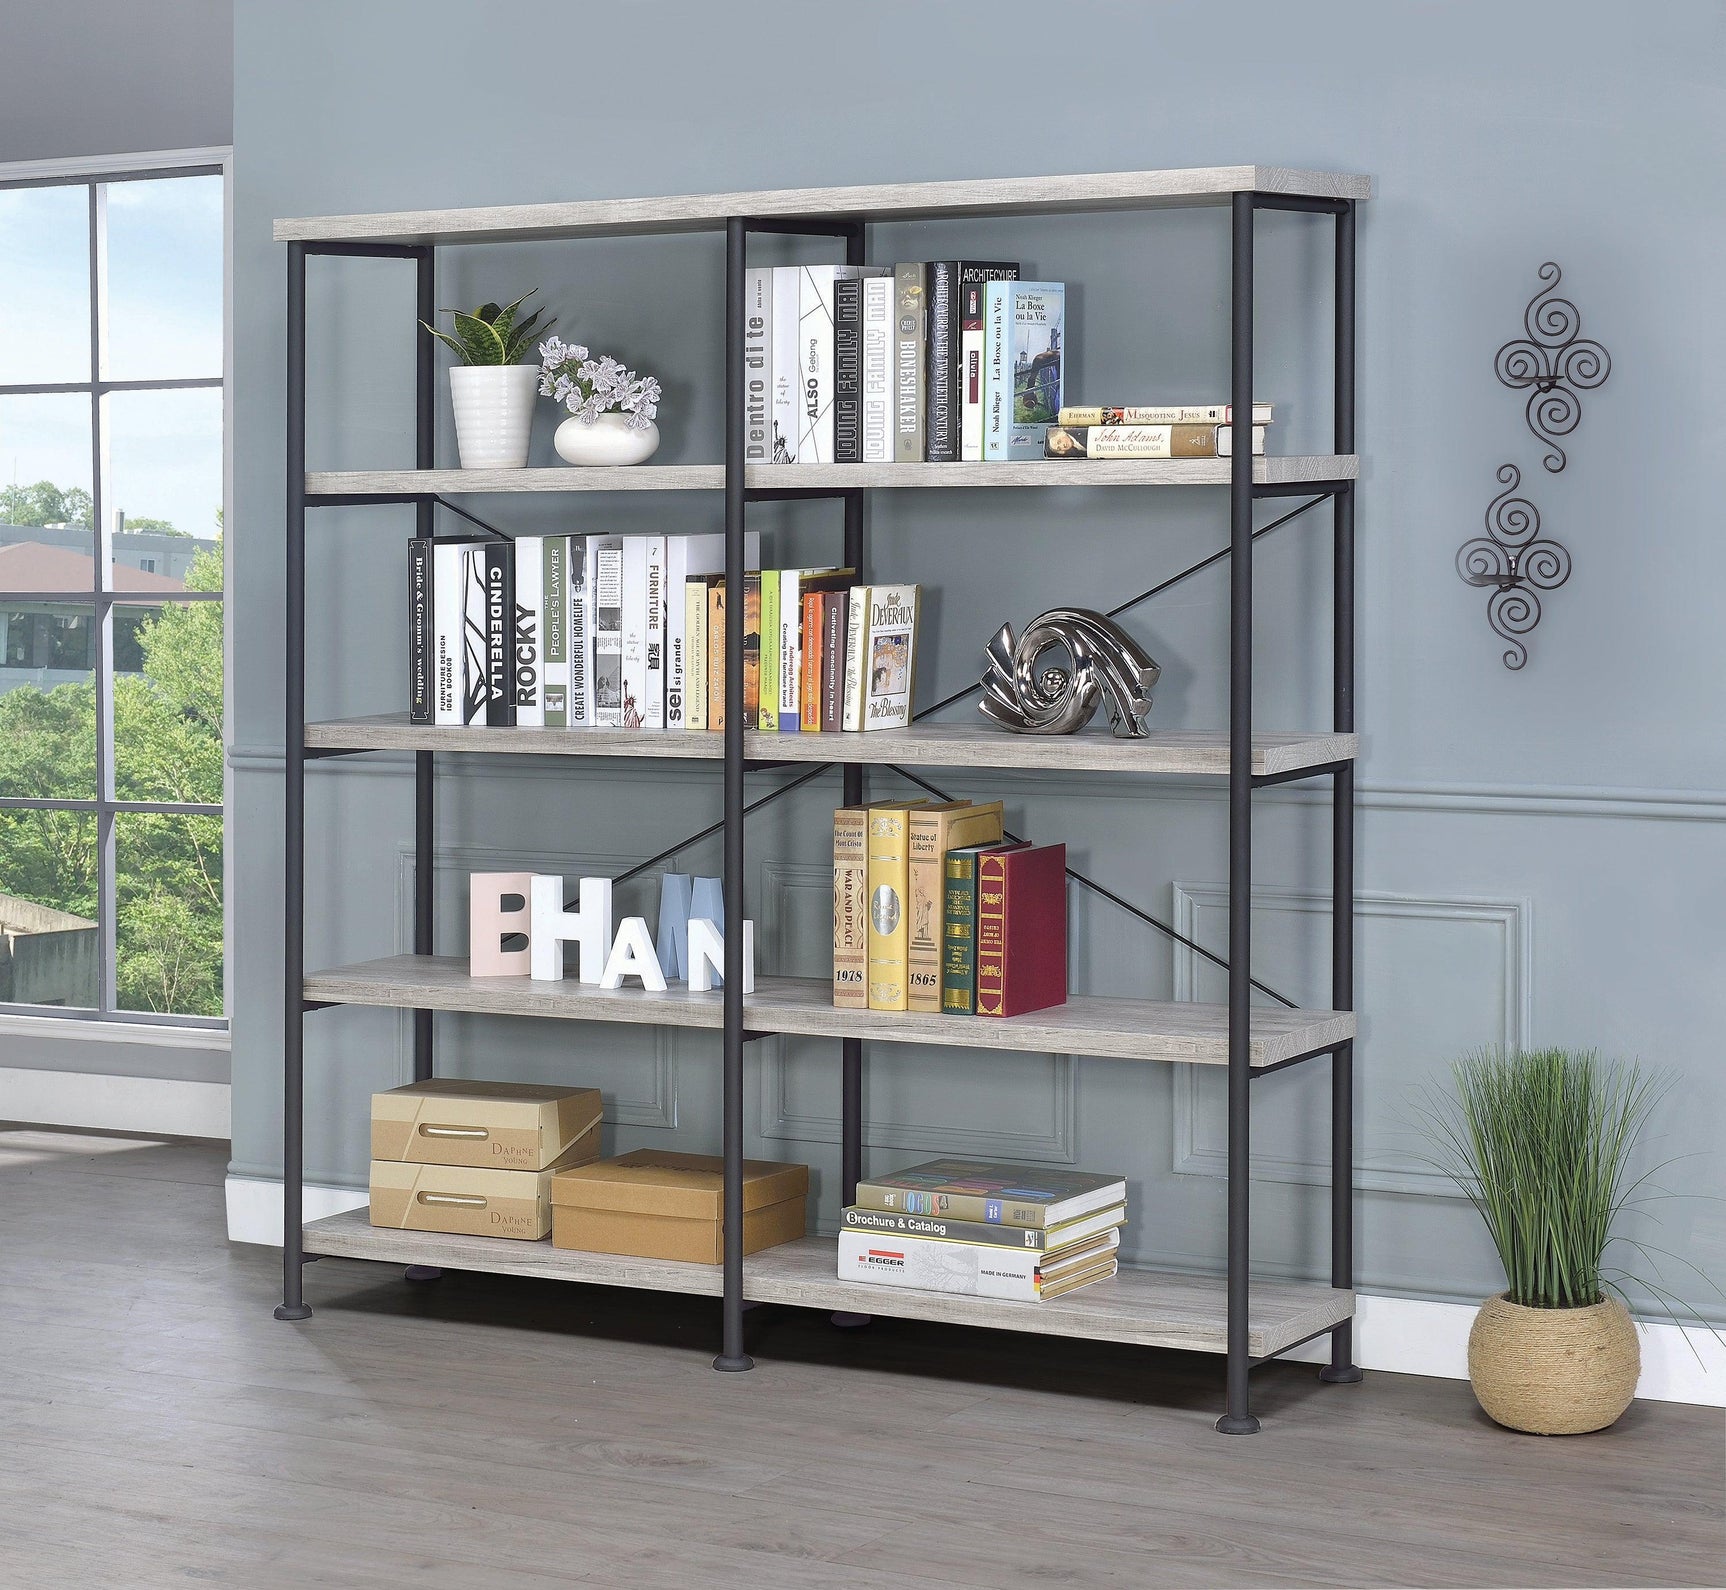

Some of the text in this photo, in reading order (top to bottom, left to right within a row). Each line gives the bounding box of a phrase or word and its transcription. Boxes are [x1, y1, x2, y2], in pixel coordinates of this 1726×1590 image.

[838, 283, 859, 322] MAN
[867, 283, 886, 321] MAN
[1016, 301, 1045, 310] La Boxe
[747, 316, 764, 339] te
[1027, 312, 1033, 320] la
[1035, 312, 1047, 321] Vie
[937, 341, 949, 357] THE
[993, 297, 1002, 381] La Boxe ou la Vie
[838, 330, 858, 394] FAMILY
[866, 330, 886, 393] FAMILY
[970, 352, 978, 378] olivia
[807, 338, 819, 419] ALSO Gelang
[900, 340, 916, 433] BONESHAKER
[937, 358, 949, 404] TWENTIETH
[746, 379, 764, 459] Dentro
[937, 405, 949, 443] CENTURY
[992, 391, 1002, 433] Noah Klieger
[1126, 409, 1176, 421] MISQUOTING
[1179, 410, 1200, 421] JESUS
[1095, 429, 1120, 442] John
[1096, 444, 1115, 452] DAVID
[652, 548, 657, 556] 7
[416, 591, 423, 601] &
[550, 549, 560, 656] PEOPLE'S LAWYER
[649, 565, 659, 630] FURNITURE
[872, 604, 913, 626] DEVERAUX
[490, 567, 503, 700] CINDERELLA
[848, 623, 860, 662] DEVERAUX
[516, 603, 536, 707] ROCKY
[573, 598, 584, 721] CREATE WONDERFUL HOMELIFE
[674, 638, 683, 674] grande
[416, 658, 424, 704] wedding
[674, 677, 681, 686] si
[845, 679, 857, 706] Blessing
[869, 702, 881, 718] The
[880, 697, 907, 720] Blessing
[911, 832, 929, 841] Statue
[913, 842, 935, 853] Liberty
[845, 870, 853, 947] WAR AND PEACE
[836, 970, 863, 982] 1978
[910, 973, 937, 986] 1865
[492, 1142, 534, 1157] DAPHNE
[504, 1157, 528, 1165] YOUNG
[490, 1211, 532, 1226] DAPHNE
[502, 1226, 526, 1234] YOUNG
[846, 1212, 946, 1236] Brochure & Catalog
[868, 1257, 905, 1267] EGGER
[1002, 1272, 1026, 1280] GERMANY
